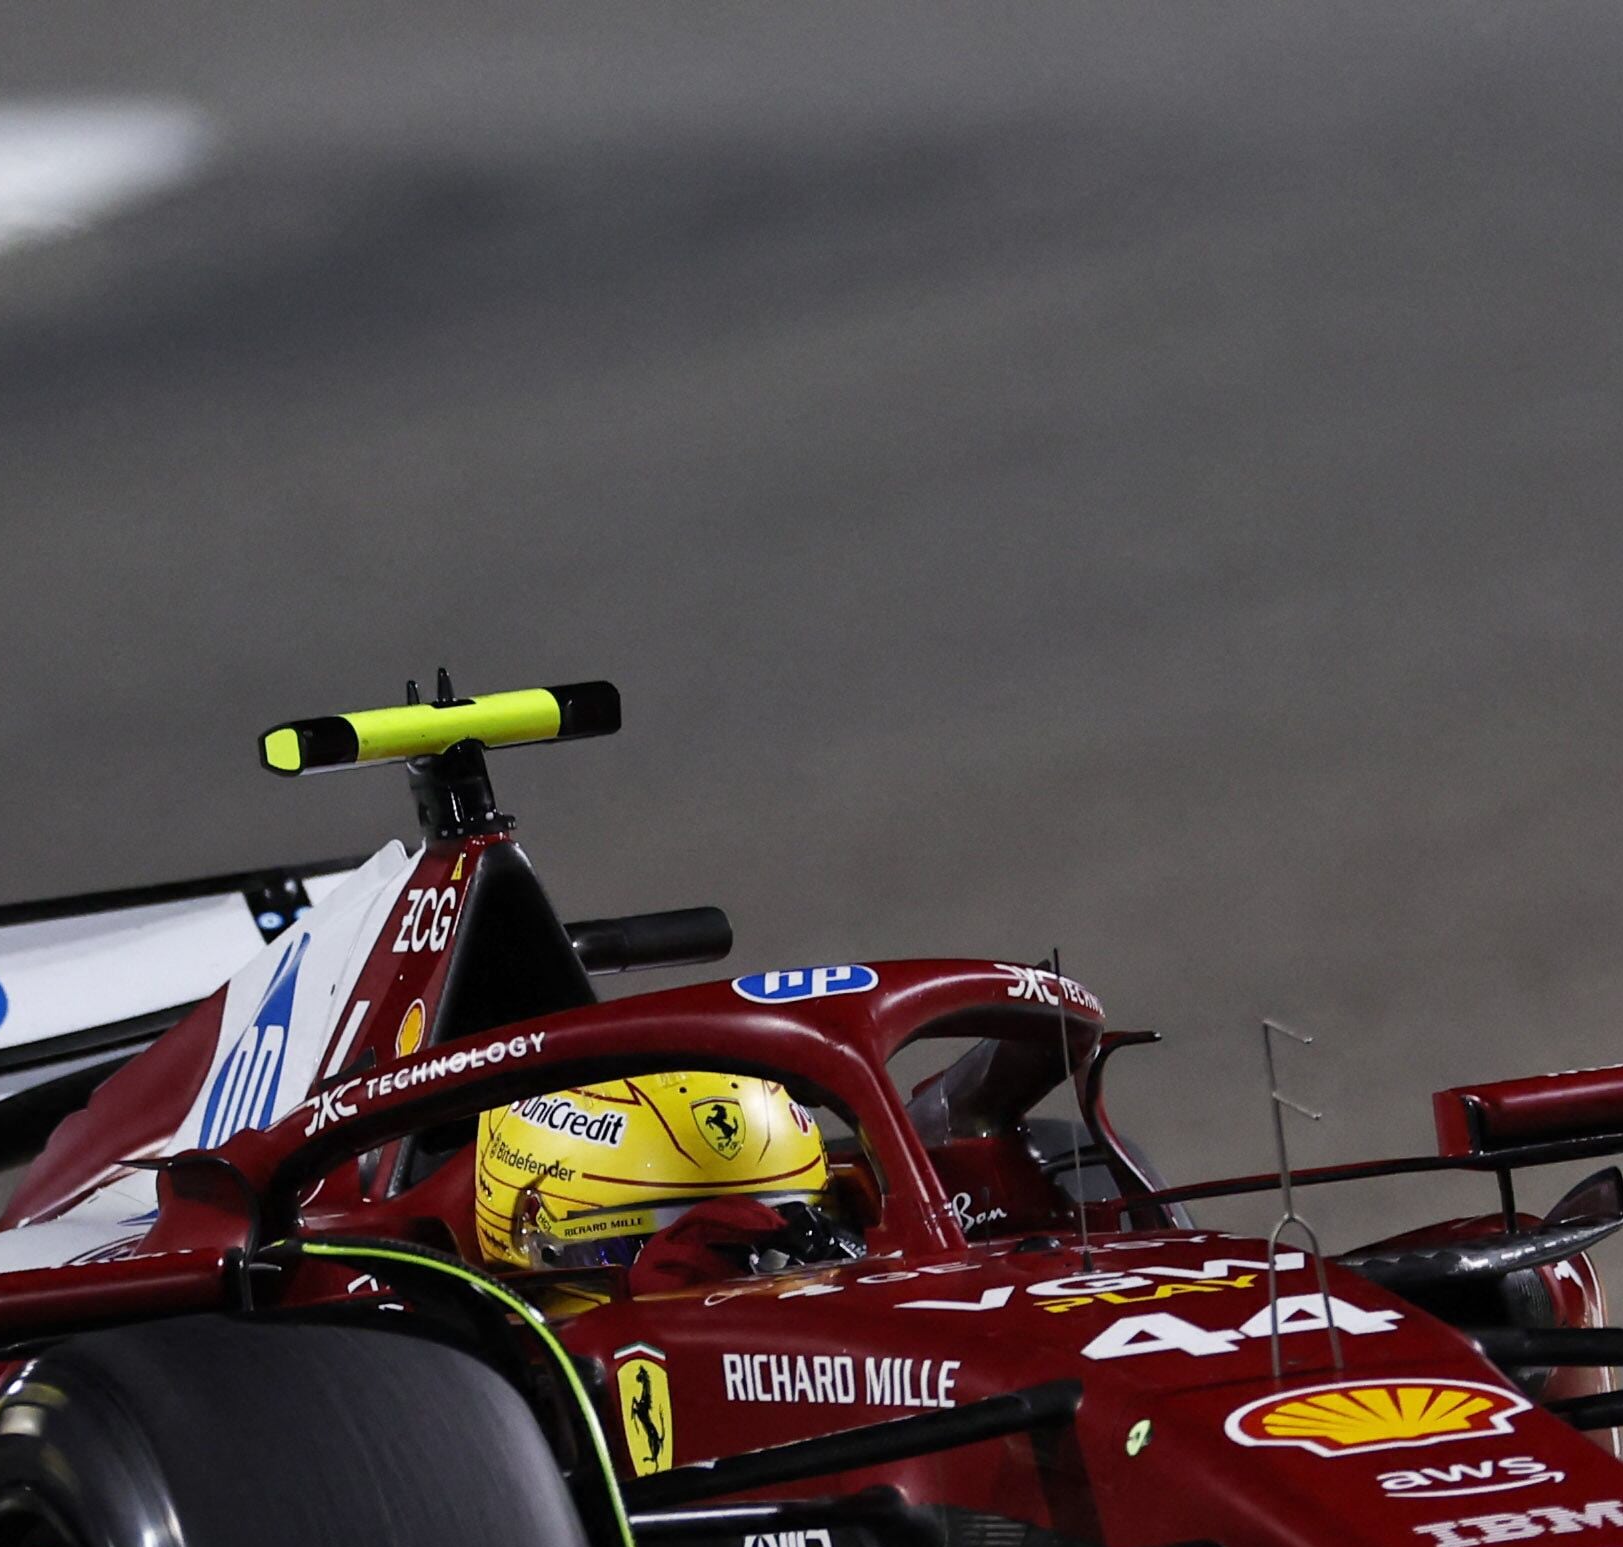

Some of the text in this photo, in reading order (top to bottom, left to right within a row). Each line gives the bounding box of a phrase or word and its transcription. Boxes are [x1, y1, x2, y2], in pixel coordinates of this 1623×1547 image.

[393, 886, 456, 953] ZCG
[366, 1031, 546, 1100] TECHNOLOGY
[521, 1094, 624, 1145] UniCredit
[496, 1145, 576, 1183] Bitdefender
[564, 1217, 643, 1238] RICHARD MILLE
[895, 1252, 1305, 1311] VGW
[1033, 1273, 1258, 1314] PLAY
[1081, 1294, 1404, 1360] 44
[722, 1352, 961, 1409] RICHARD MILLE
[1376, 1456, 1549, 1492] aws
